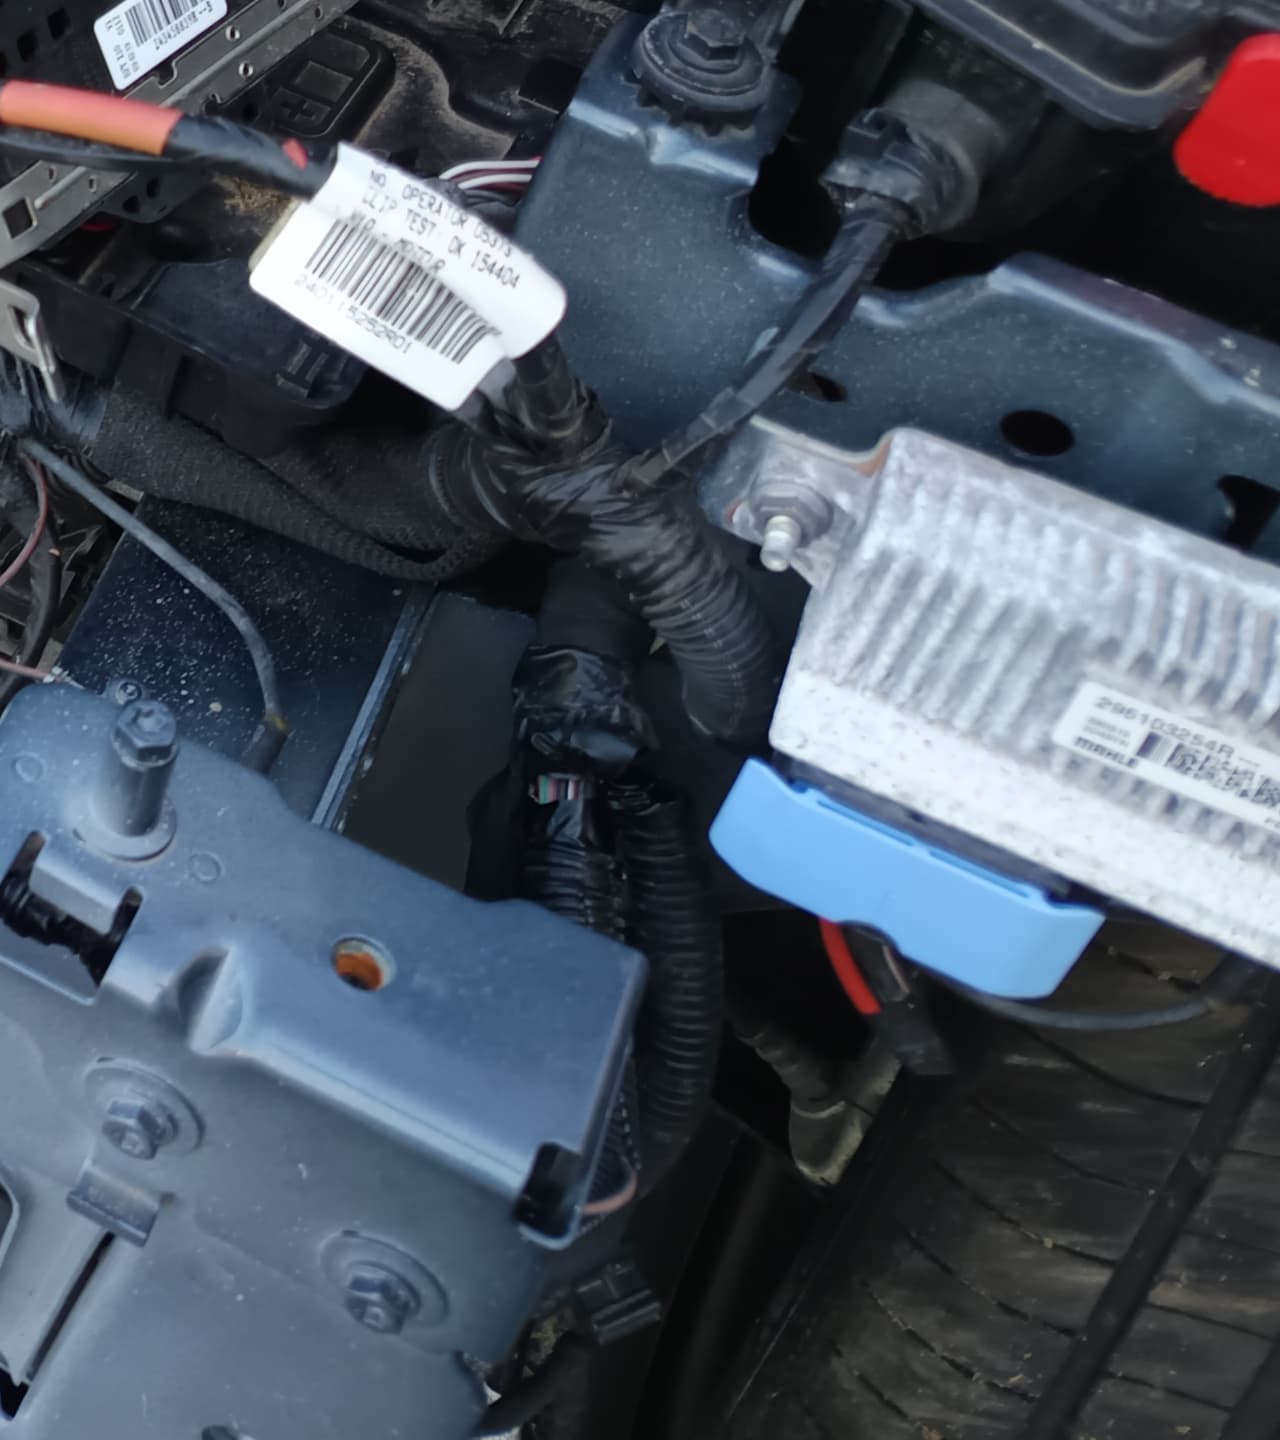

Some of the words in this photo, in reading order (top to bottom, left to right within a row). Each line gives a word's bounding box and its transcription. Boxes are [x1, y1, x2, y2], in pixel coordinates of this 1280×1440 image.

[401, 183, 469, 229] OPERATOR
[406, 207, 437, 236] TEST
[447, 234, 467, 256] OK
[470, 249, 521, 289] 154404
